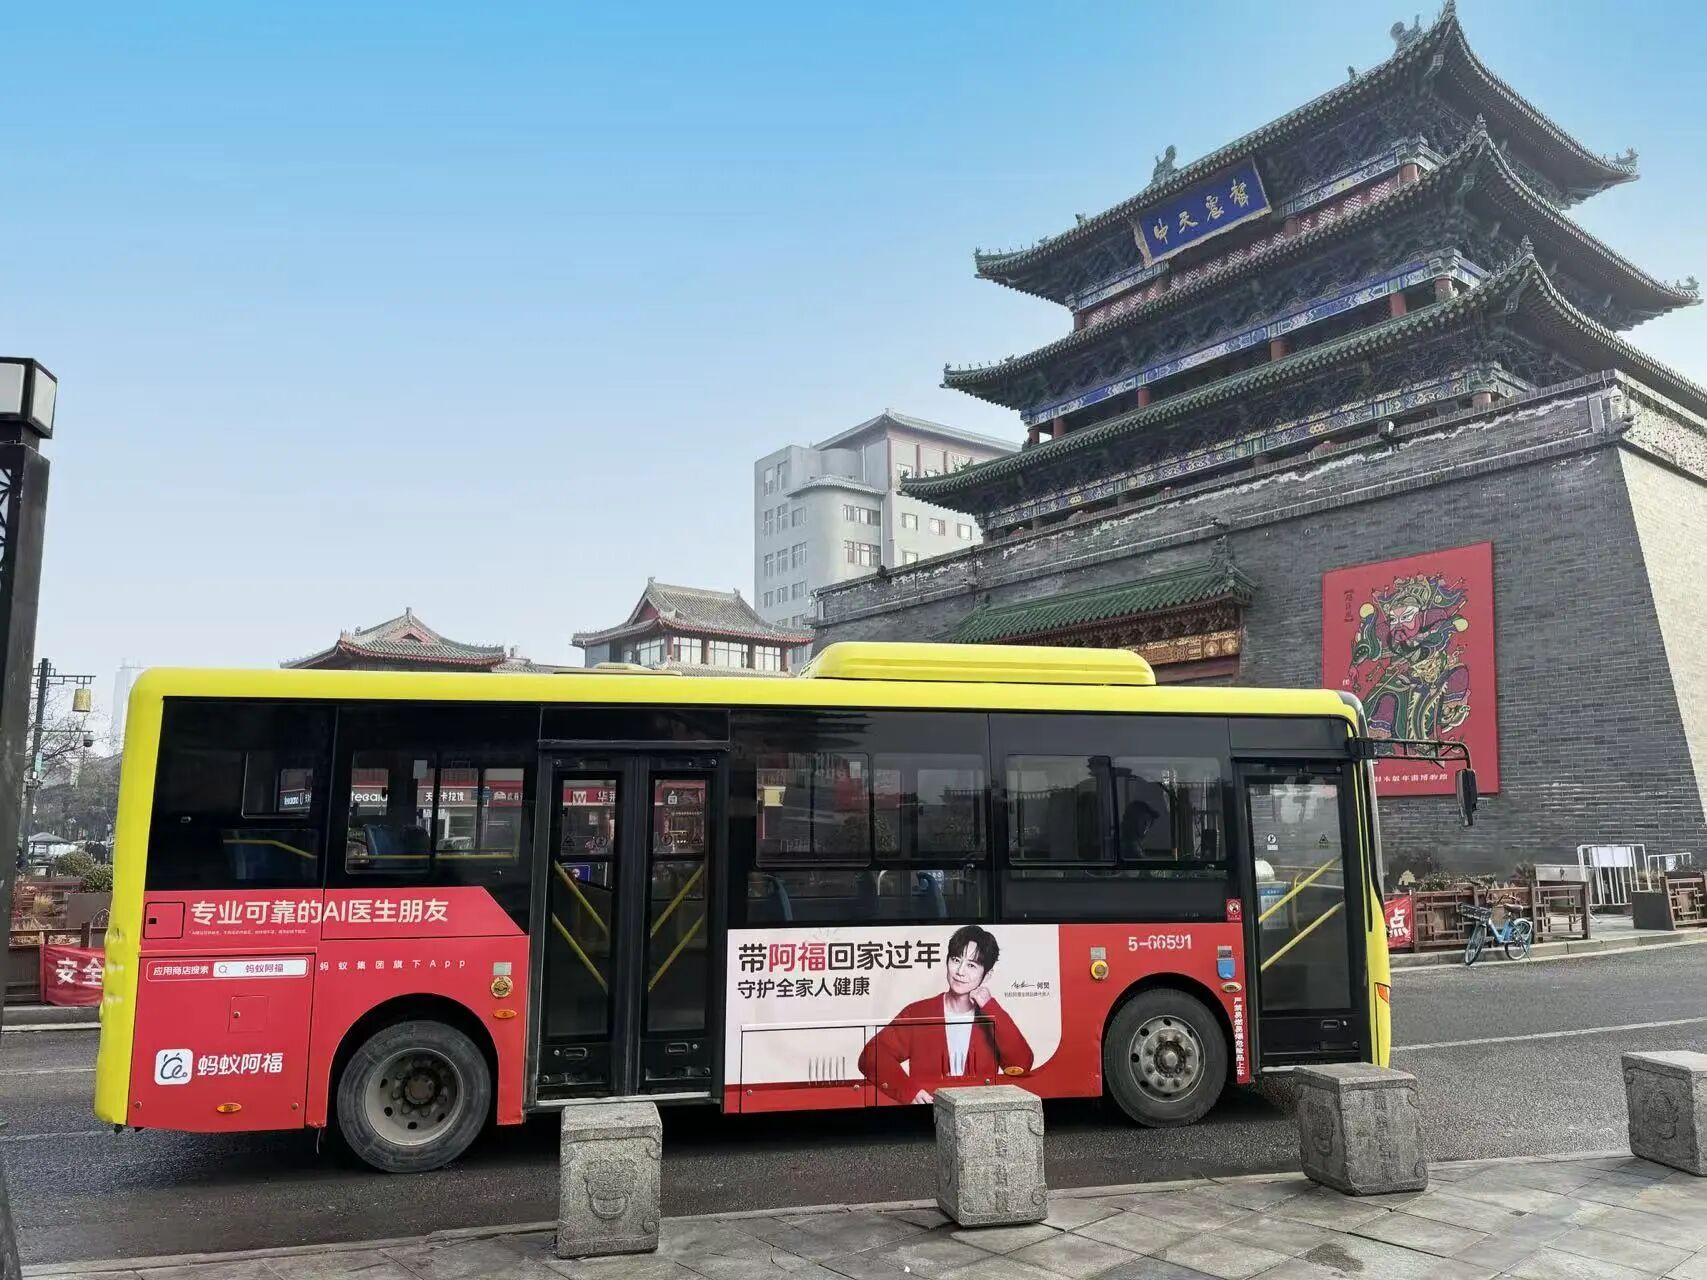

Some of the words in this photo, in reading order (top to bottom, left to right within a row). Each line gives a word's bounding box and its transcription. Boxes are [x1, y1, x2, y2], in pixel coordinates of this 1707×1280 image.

[190, 898, 449, 926] 专业可靠的AI医生朋友
[1127, 934, 1192, 952] 5-66591
[738, 940, 941, 972] 带阿福回家过年
[55, 957, 103, 985] 安全
[152, 965, 209, 977] 应用商店搜索
[245, 962, 284, 974] 蚂蚁阿福
[737, 976, 871, 999] 守护全家人健康
[197, 1052, 284, 1076] 蚂蚁阿福
